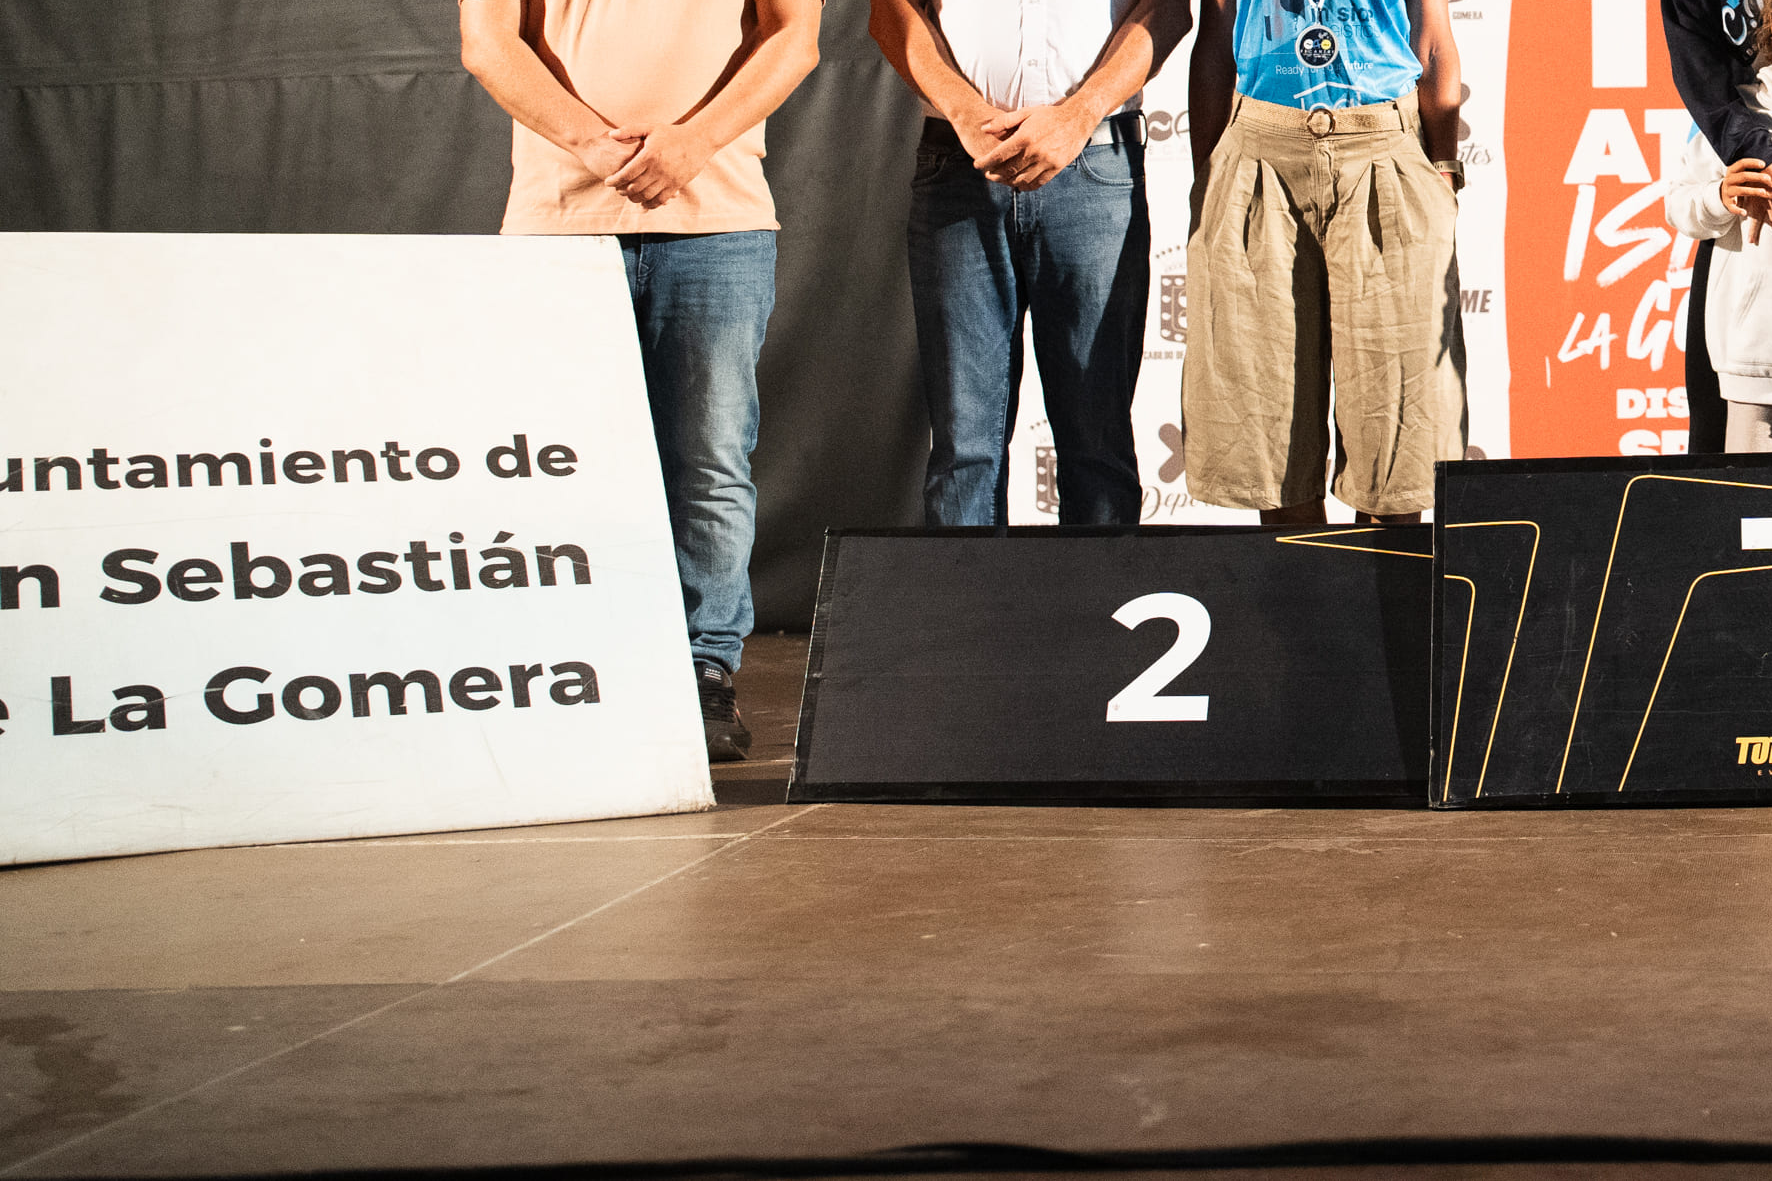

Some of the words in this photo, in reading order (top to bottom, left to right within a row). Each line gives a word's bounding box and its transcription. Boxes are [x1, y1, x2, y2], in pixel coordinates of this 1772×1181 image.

[0, 438, 460, 492] untamiento
[486, 434, 578, 478] de
[99, 531, 592, 605] Sebastián
[1106, 592, 1211, 722] 2
[51, 675, 167, 736] La
[204, 660, 601, 725] Gomera
